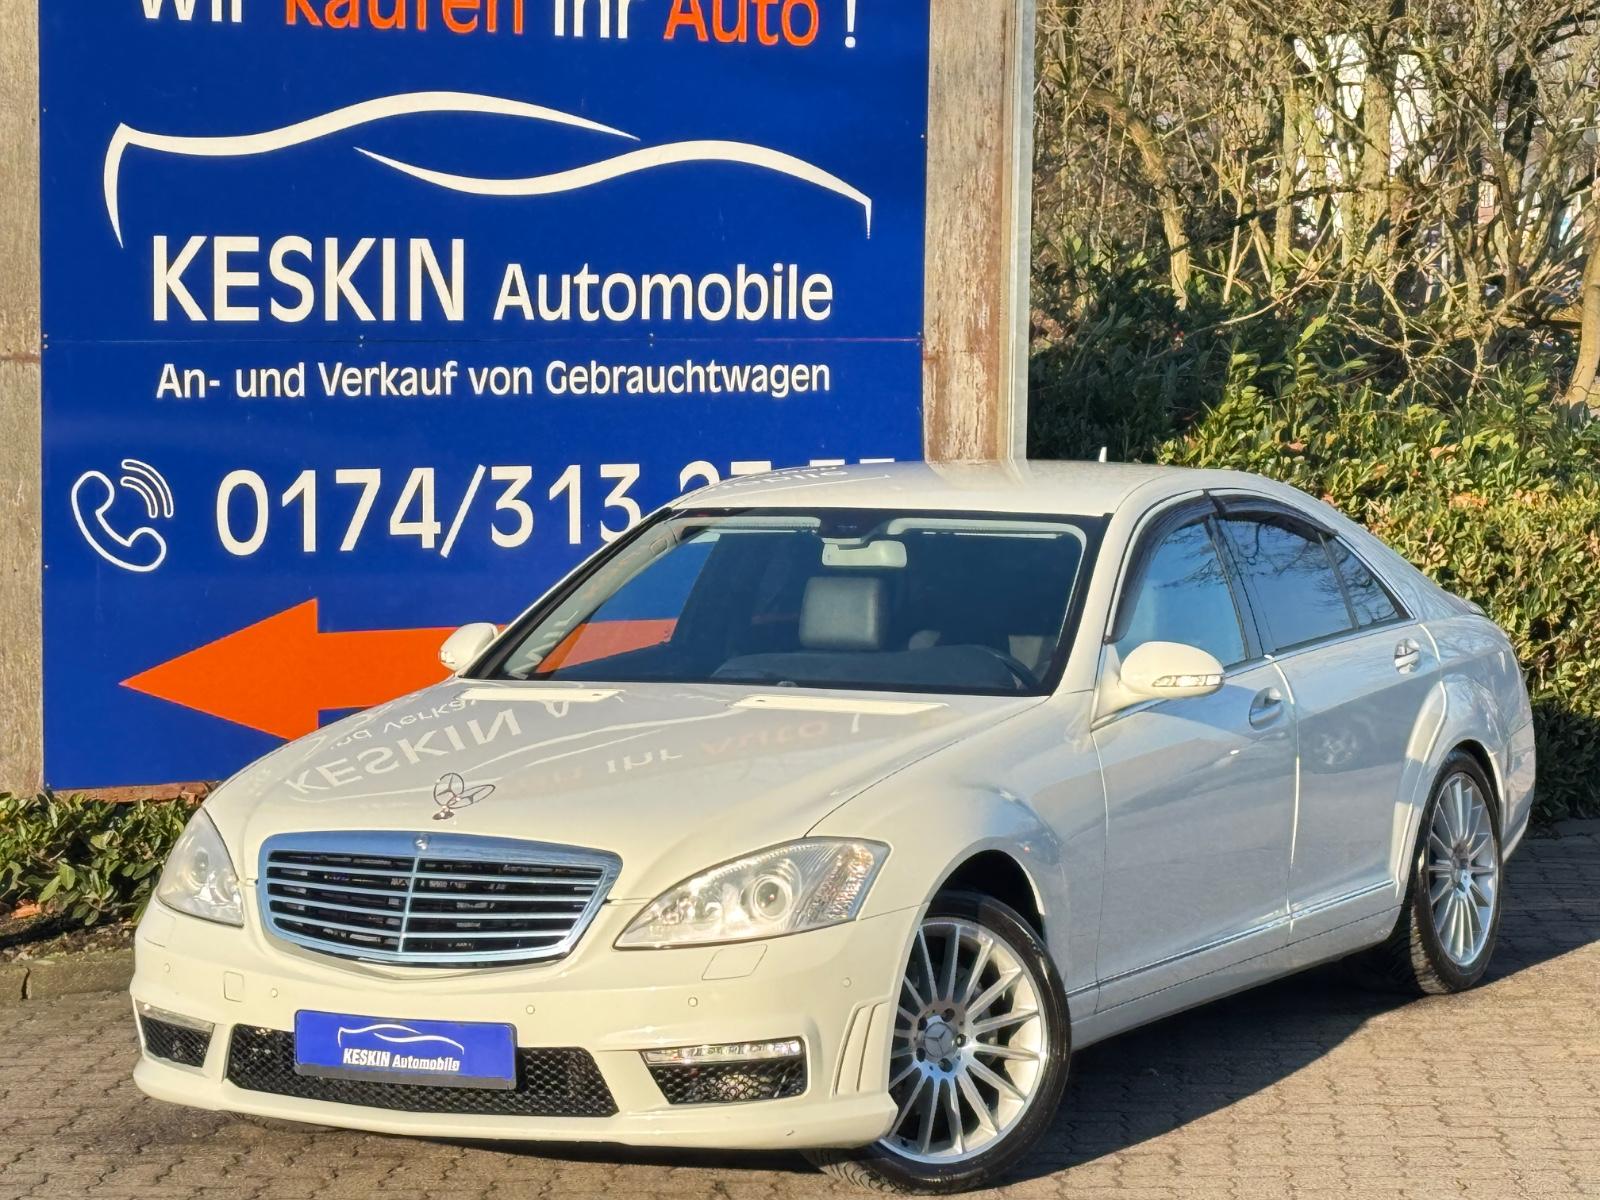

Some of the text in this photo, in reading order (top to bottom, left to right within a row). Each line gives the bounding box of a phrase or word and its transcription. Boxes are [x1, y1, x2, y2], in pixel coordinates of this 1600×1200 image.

[663, 0, 820, 46] Auto
[154, 236, 833, 322] KESKIN Automobile
[157, 359, 830, 399] An- und Verkauf von Gebrauchtwagen
[217, 464, 641, 558] 0174/313
[343, 1048, 461, 1072] KESKIN Automobile
